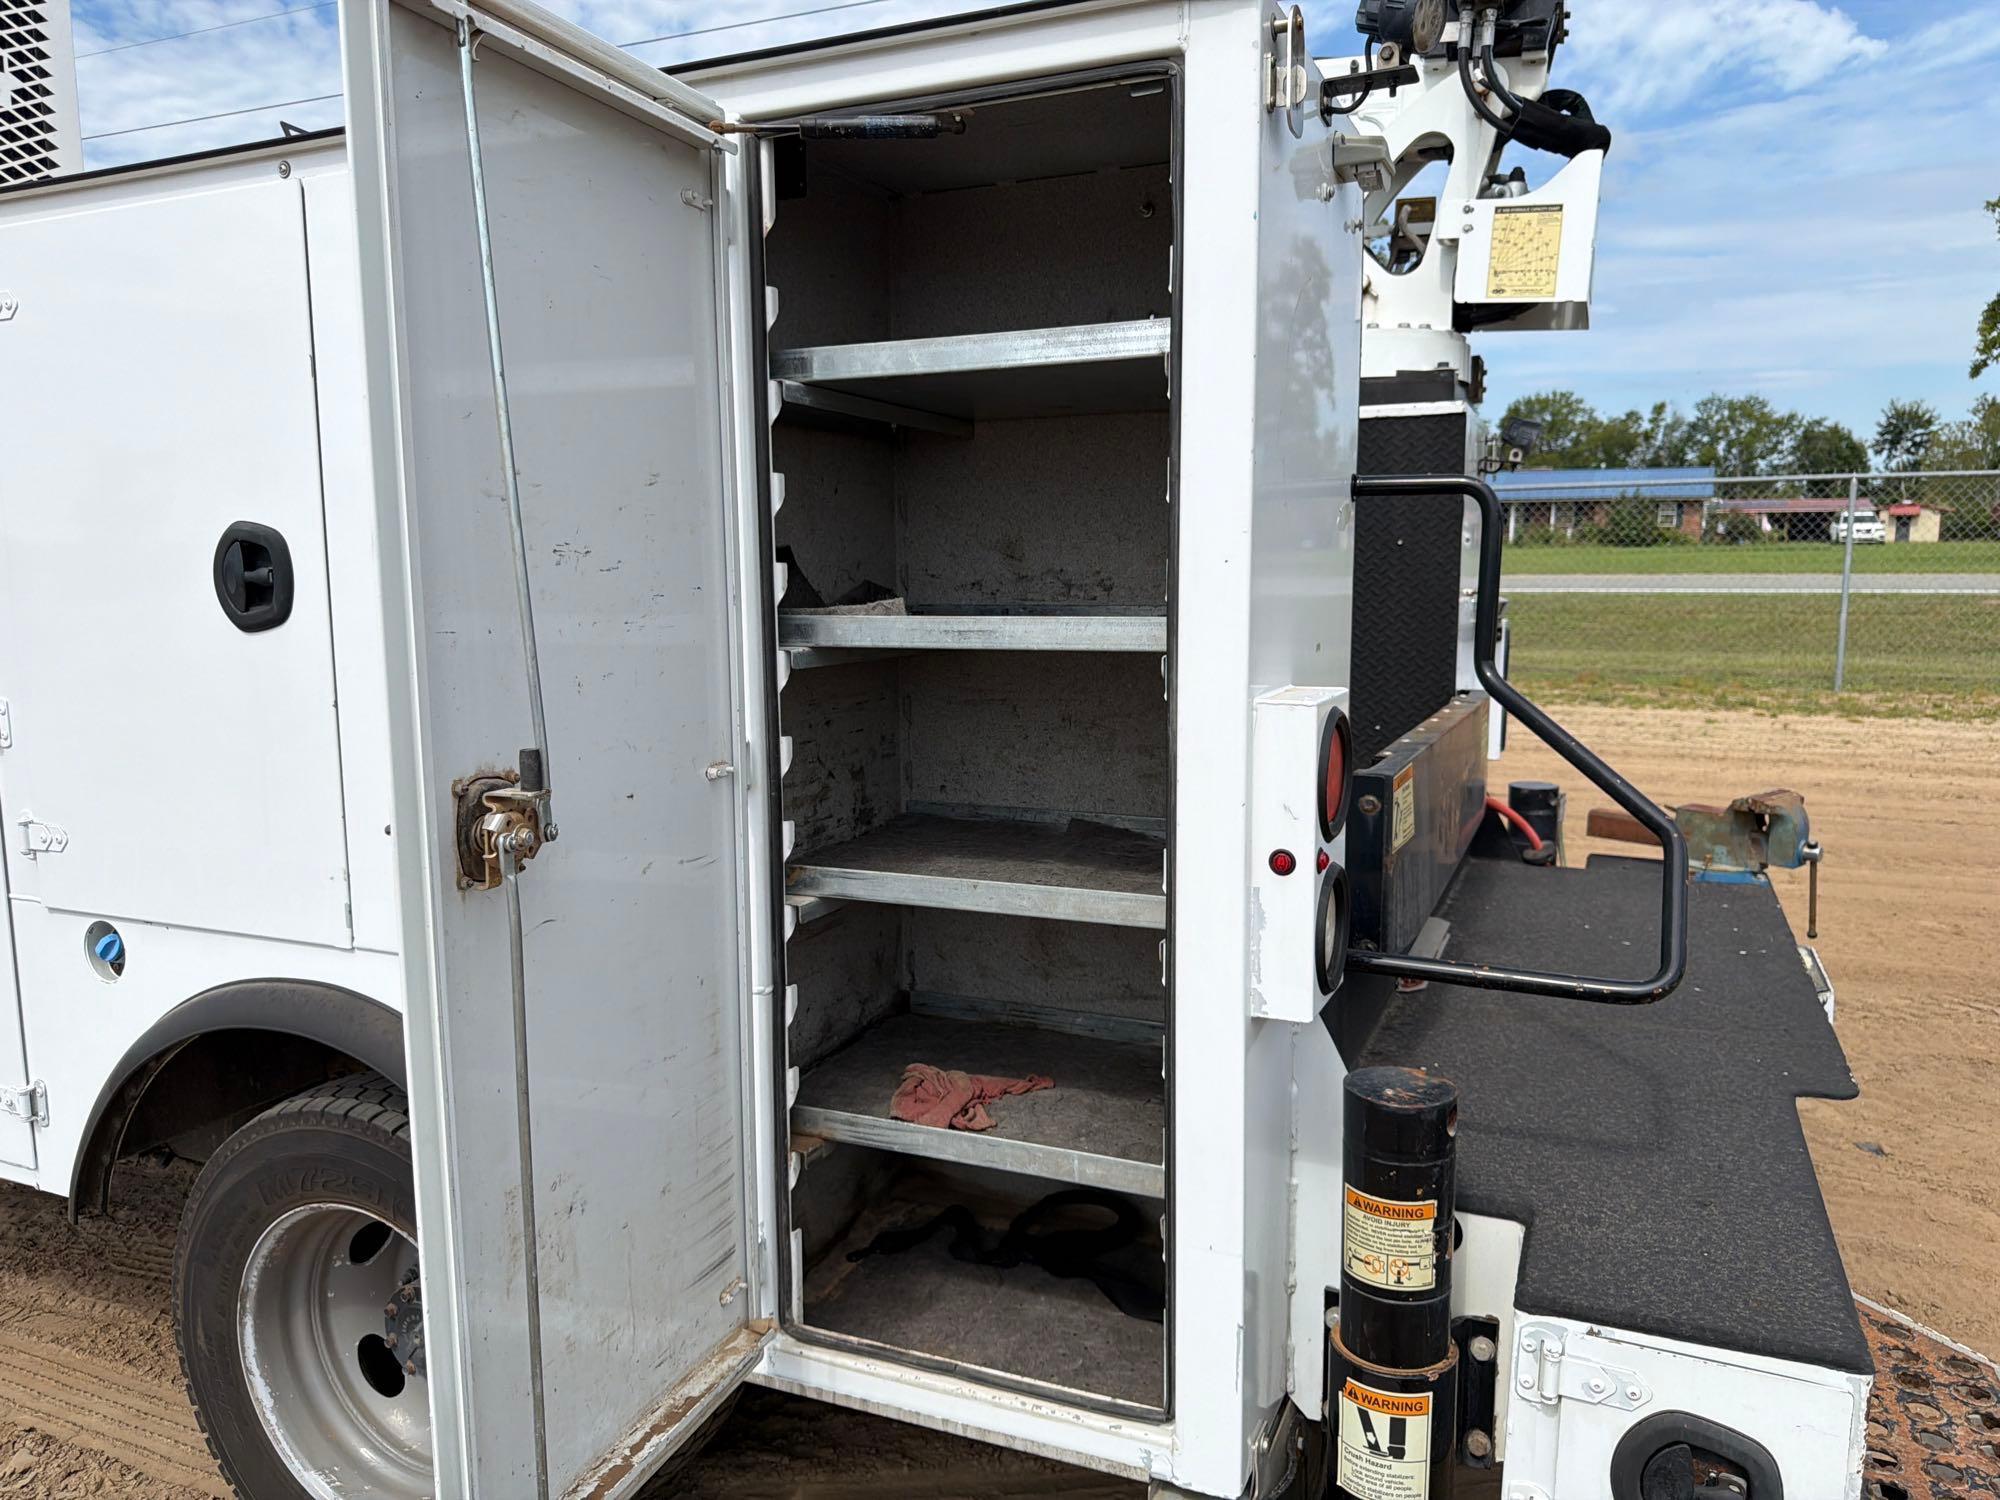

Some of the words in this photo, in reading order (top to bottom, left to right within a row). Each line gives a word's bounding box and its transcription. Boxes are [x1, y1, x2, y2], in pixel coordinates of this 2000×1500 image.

[1363, 1202, 1424, 1218] WARNING
[1362, 1214, 1383, 1224] AVOID
[1384, 1220, 1411, 1228] INJURY
[1362, 1394, 1424, 1412] WARNING
[1344, 1446, 1364, 1462] Crush
[1365, 1457, 1392, 1469] Hazard
